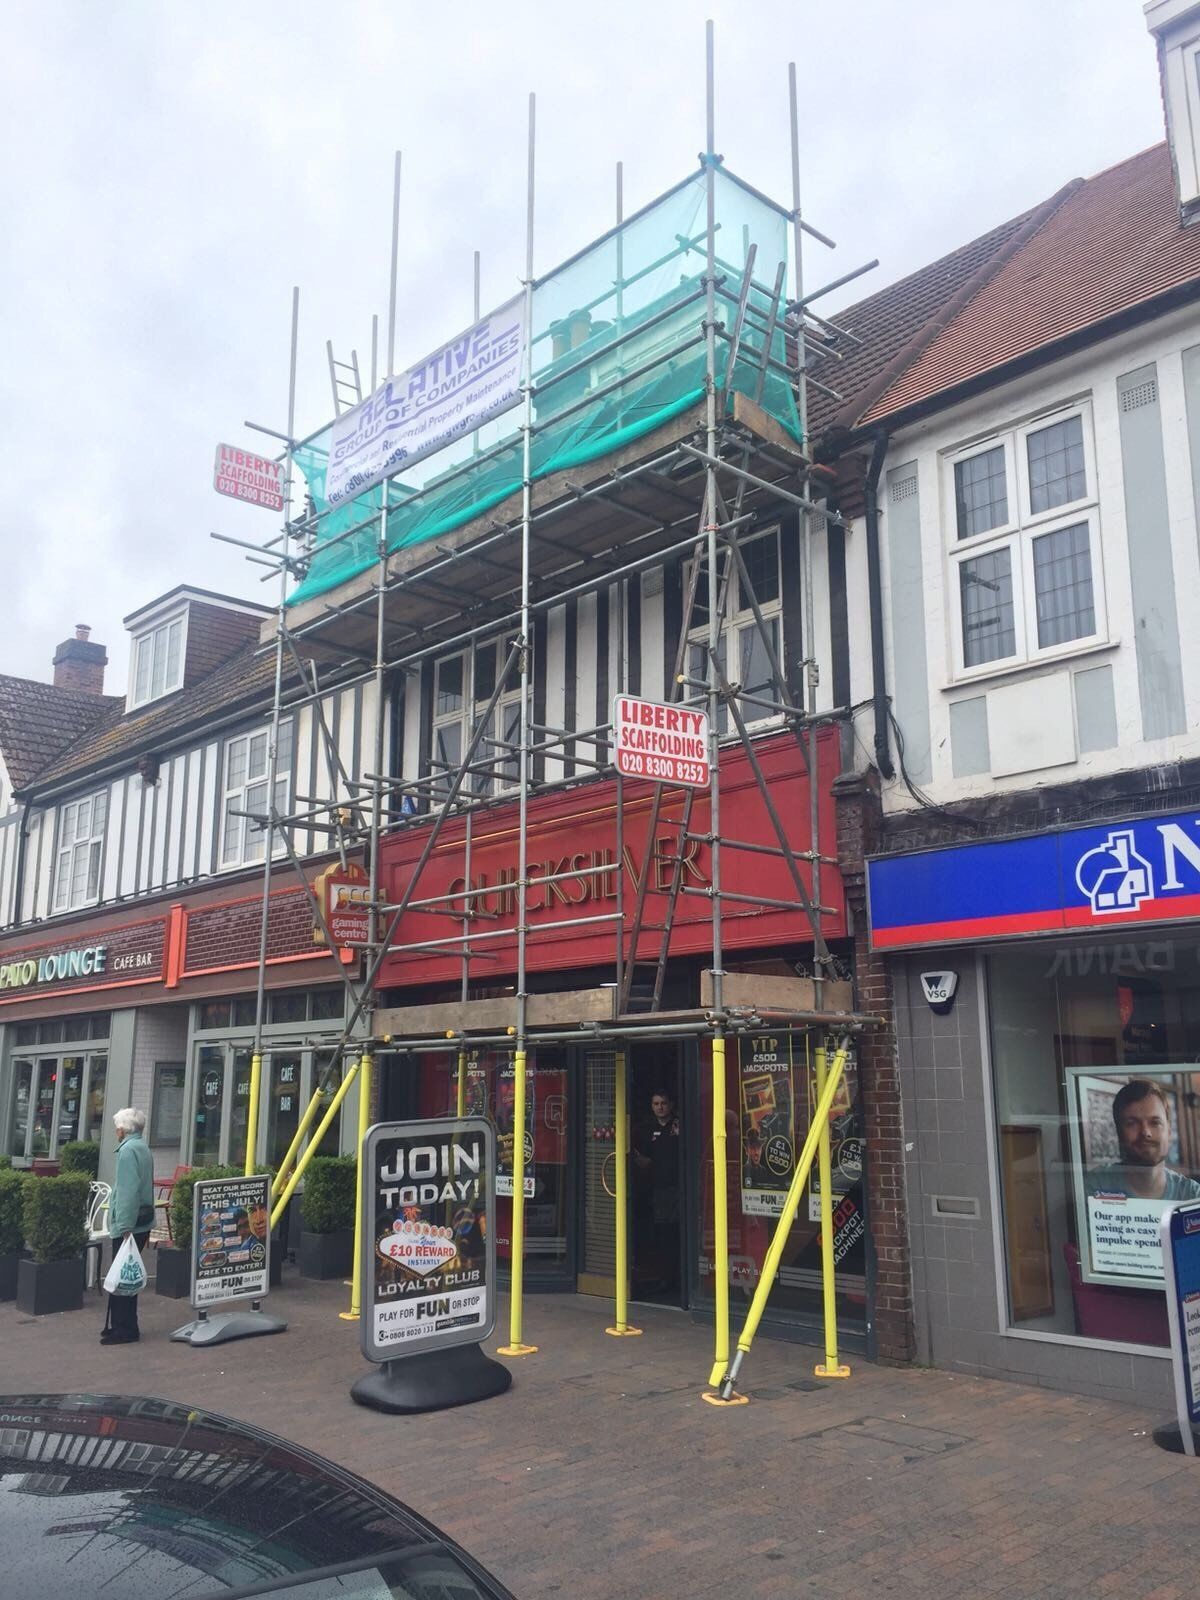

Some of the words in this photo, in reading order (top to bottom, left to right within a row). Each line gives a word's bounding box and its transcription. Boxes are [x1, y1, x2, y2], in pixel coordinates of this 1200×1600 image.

[334, 417, 383, 459] GROUP
[385, 404, 411, 422] OF
[415, 333, 520, 407] COMPANIES
[428, 400, 464, 428] Property
[221, 447, 280, 478] LIBERTY
[220, 462, 280, 494] SCAFFOLDING
[219, 478, 236, 494] 020
[237, 484, 258, 500] 8300
[260, 492, 280, 508] 8252
[621, 700, 704, 735] LIBERTY
[621, 726, 704, 759] SCAFFOLDING
[622, 753, 643, 773] 020
[646, 757, 673, 777] 8300
[677, 762, 704, 782] 8252
[446, 835, 707, 921] QUICKSILVER
[332, 917, 369, 931] gaming
[334, 928, 367, 939] centre
[37, 945, 107, 982] LOUNGE
[136, 952, 153, 967] BAR
[927, 989, 947, 999] VSG
[751, 1038, 778, 1053] VIP
[752, 1053, 777, 1062] £500
[743, 1063, 789, 1073] JACKPOTS
[280, 1096, 291, 1111] BAR
[775, 1140, 785, 1151] £1
[778, 1149, 790, 1160] WIN
[842, 1150, 852, 1158] TO
[380, 1142, 480, 1182] JOIN
[202, 1186, 223, 1194] BEAT
[240, 1182, 265, 1190] SCORE
[202, 1193, 226, 1201] EVERY
[227, 1189, 265, 1198] THURSDAY
[380, 1179, 480, 1209] TODAY!
[202, 1199, 230, 1209] THIS
[232, 1195, 264, 1207] JULY!
[760, 1194, 776, 1205] FUN
[1094, 1210, 1113, 1221] Our
[1115, 1214, 1132, 1224] app
[1095, 1223, 1123, 1235] saving
[1137, 1228, 1157, 1238] easy
[1096, 1233, 1132, 1246] impulse
[390, 1244, 413, 1257] £10
[415, 1246, 455, 1257] REWARD
[408, 1258, 440, 1266] INSTANTLY
[199, 1269, 220, 1278] FREE
[234, 1262, 263, 1271] ENTER!
[221, 1276, 244, 1289] FUN
[378, 1276, 442, 1297] LOYALTY
[445, 1270, 480, 1286] CLUB
[379, 1311, 398, 1322] PLAY
[400, 1308, 415, 1319] FOR
[416, 1298, 450, 1320] FUN
[452, 1300, 462, 1309] OR
[463, 1296, 480, 1307] STOP
